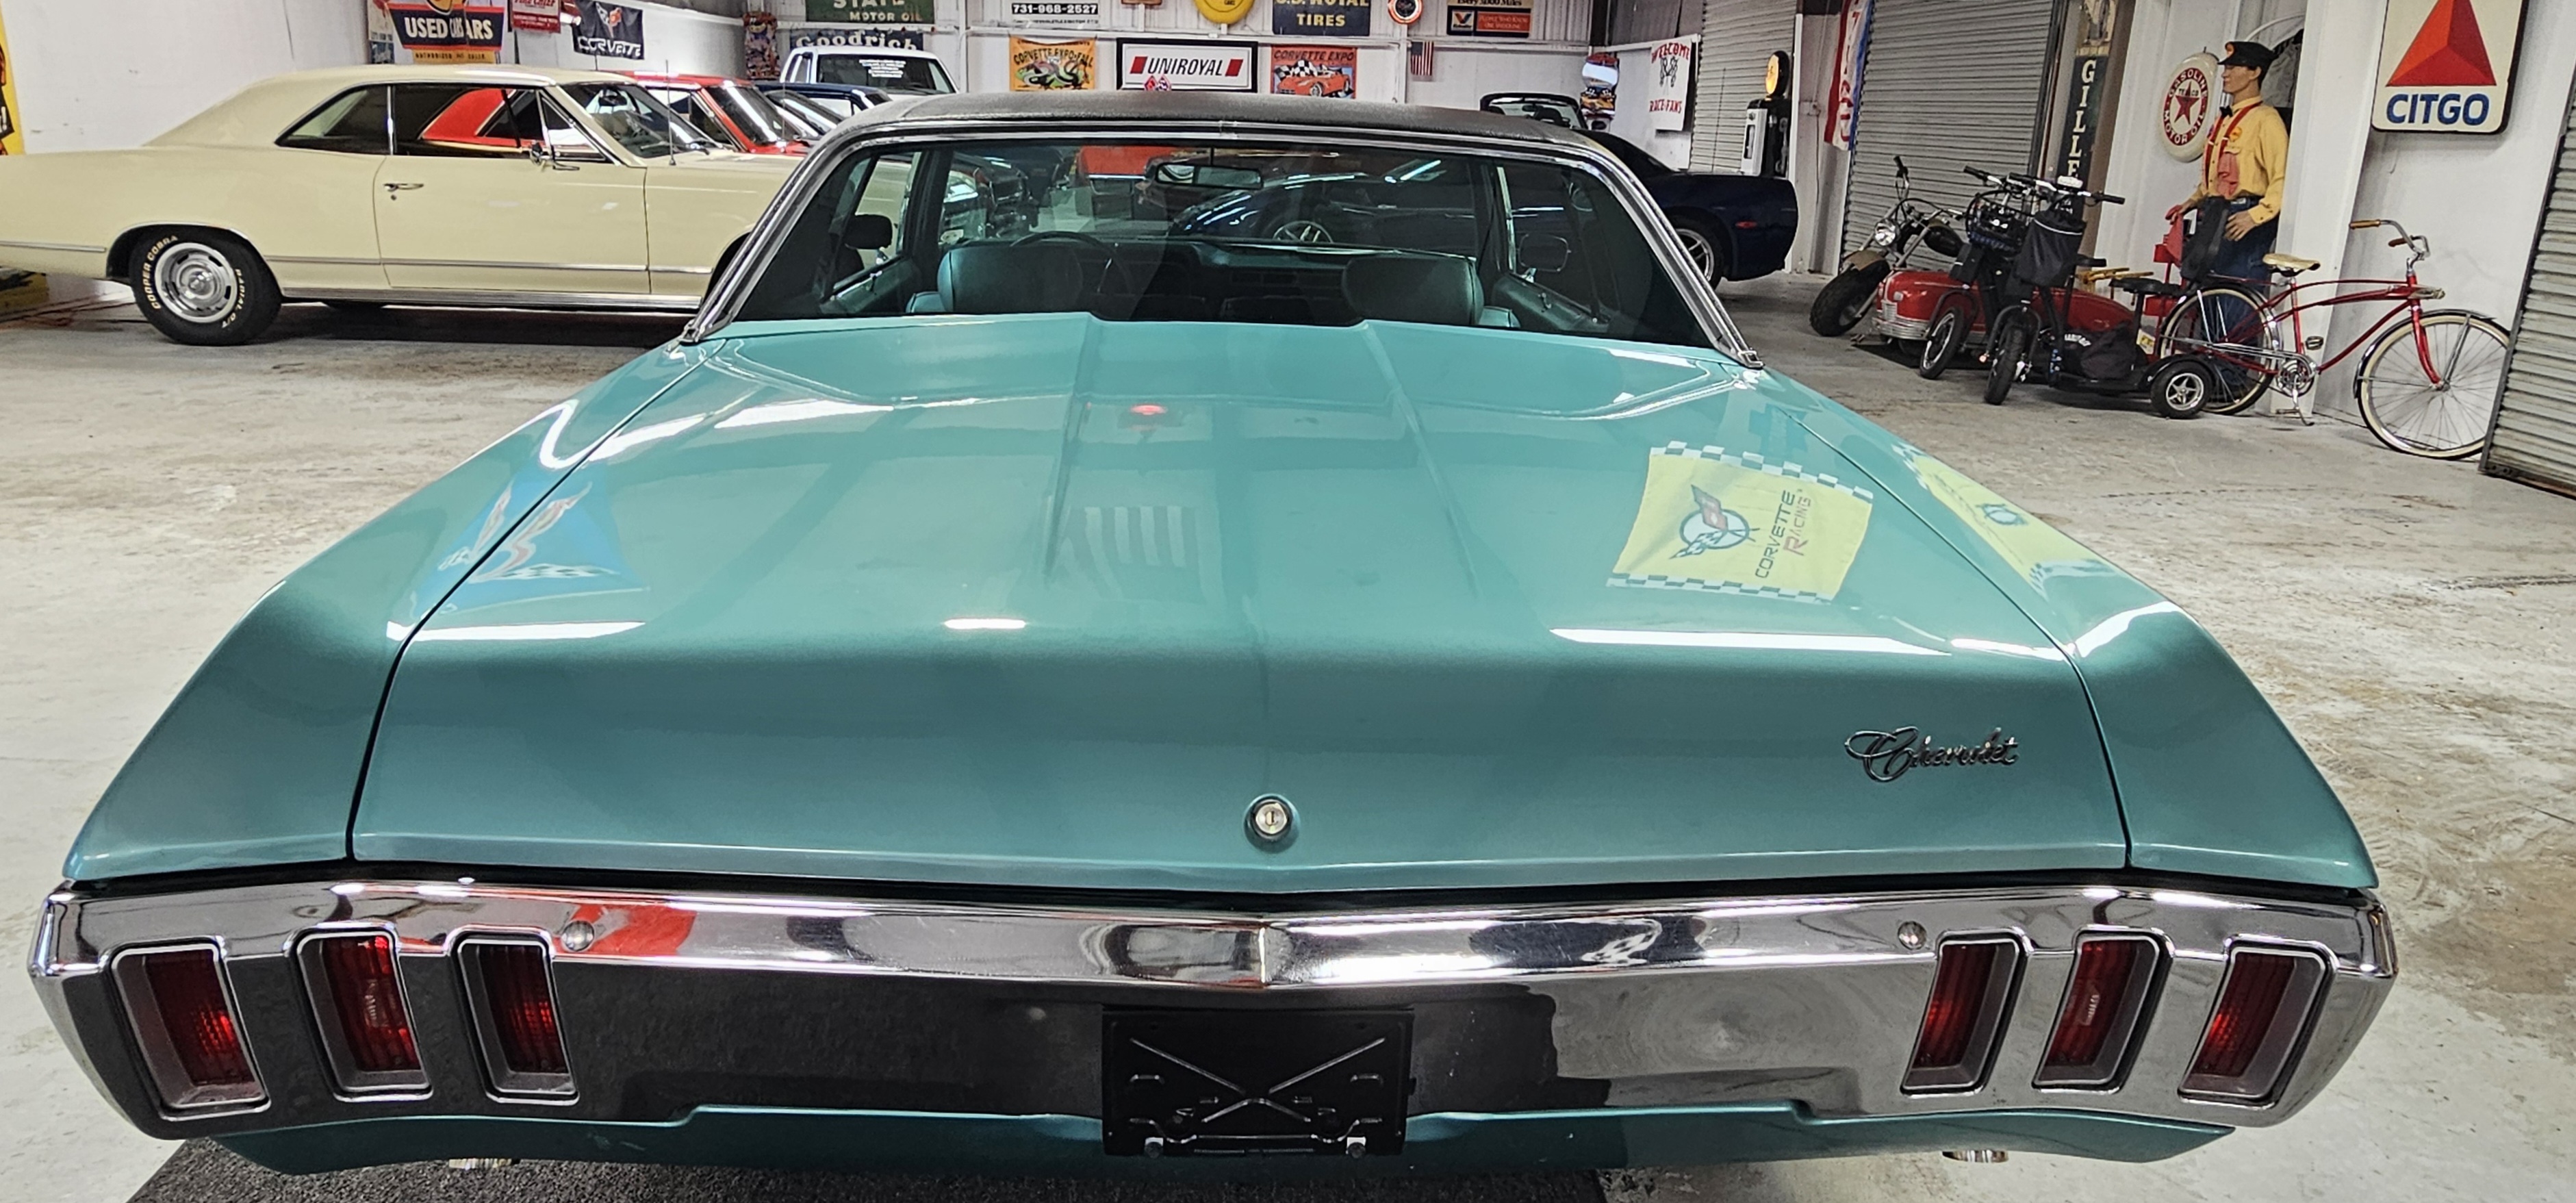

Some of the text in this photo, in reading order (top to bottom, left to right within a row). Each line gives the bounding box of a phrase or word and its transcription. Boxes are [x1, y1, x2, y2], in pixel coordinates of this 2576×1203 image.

[849, 12, 923, 22] MOTOR OIL
[1012, 4, 1097, 14] 731-968-2527
[1296, 13, 1346, 27] TIRES
[404, 16, 448, 39] USED
[577, 36, 641, 57] CORVETTE
[1013, 47, 1053, 66] CORVETTE
[1273, 49, 1355, 62] CORVETTE EXPO
[1651, 42, 1690, 64] WELCOME
[1147, 58, 1223, 76] UNIROYAL
[2386, 93, 2490, 126] CITGO
[2164, 110, 2206, 144] MOTOR OIL
[142, 235, 179, 309] COOPER COBRA
[1755, 490, 1796, 579] CORVETTE
[1783, 496, 1811, 557] RACING
[1844, 726, 2019, 783] Chevrolet
